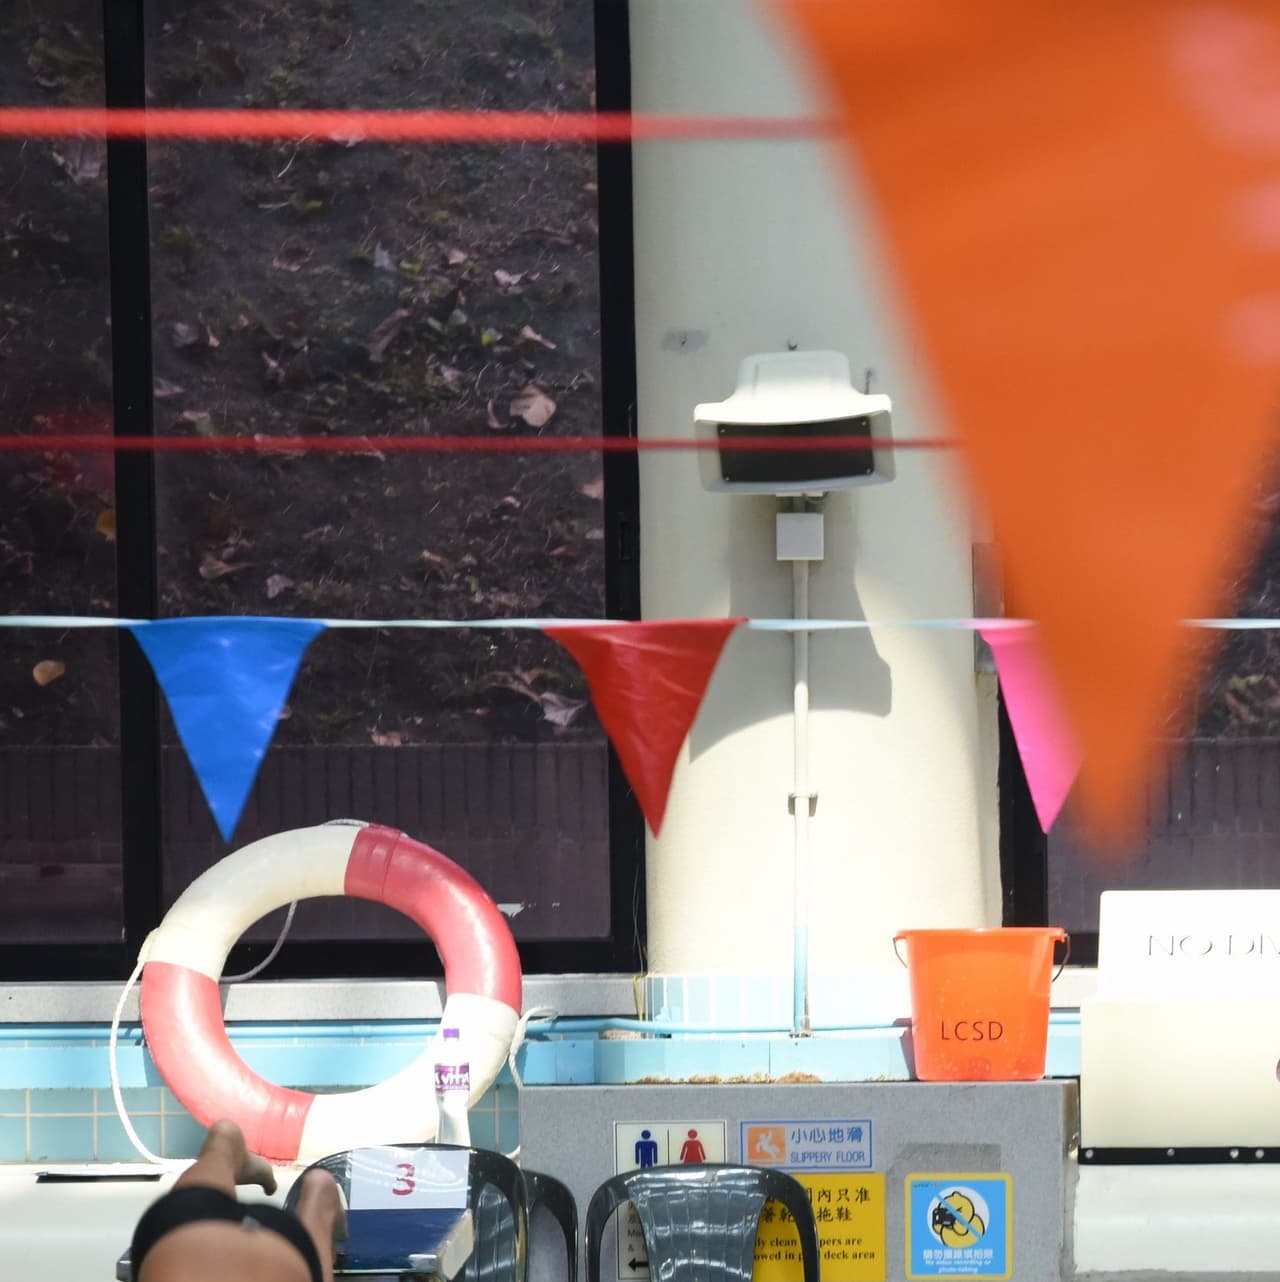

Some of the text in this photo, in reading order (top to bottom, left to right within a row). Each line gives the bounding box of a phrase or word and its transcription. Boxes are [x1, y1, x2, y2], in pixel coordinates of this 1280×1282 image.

[940, 1020, 1004, 1041] LCSD
[790, 1151, 866, 1164] SLIPPERY FLOOR
[392, 1163, 416, 1196] 3
[770, 1237, 798, 1247] clean
[785, 1251, 795, 1261] in
[824, 1249, 849, 1261] deck
[852, 1252, 876, 1260] area
